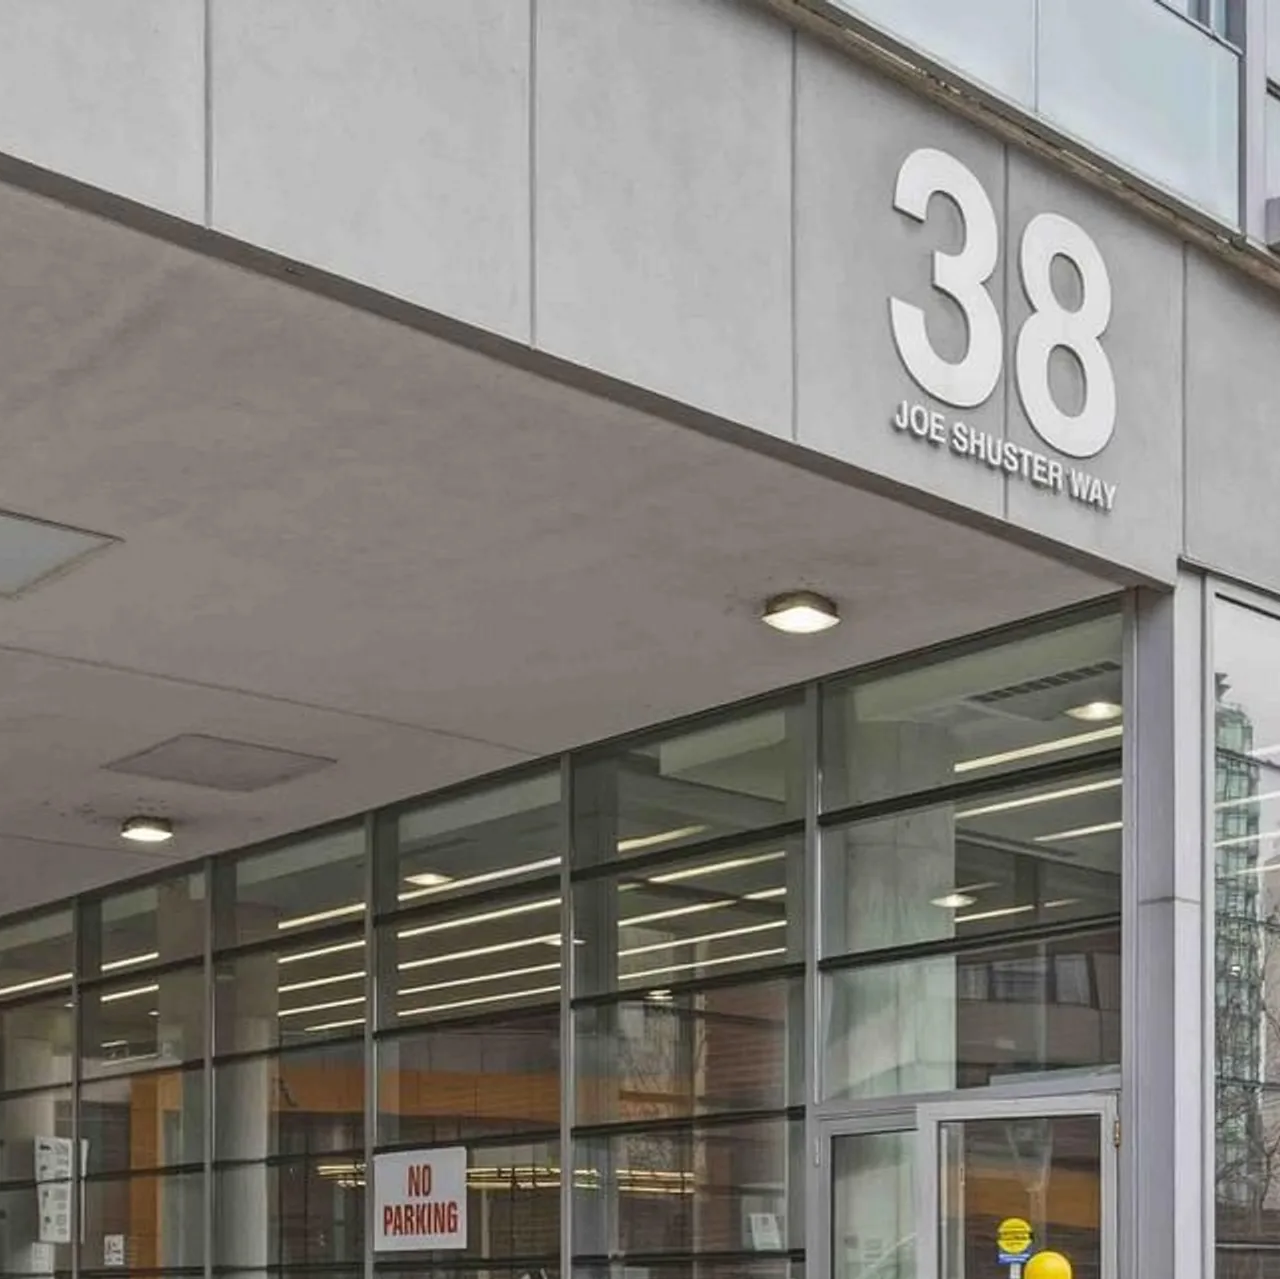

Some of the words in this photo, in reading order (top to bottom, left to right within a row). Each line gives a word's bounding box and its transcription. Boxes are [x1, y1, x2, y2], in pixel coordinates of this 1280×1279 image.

[890, 147, 1117, 458] 38
[894, 400, 947, 444] JOE
[951, 421, 1064, 490] SHUSTER
[1068, 465, 1117, 511] WAY
[407, 1164, 432, 1197] NO
[383, 1201, 458, 1237] PARKING
